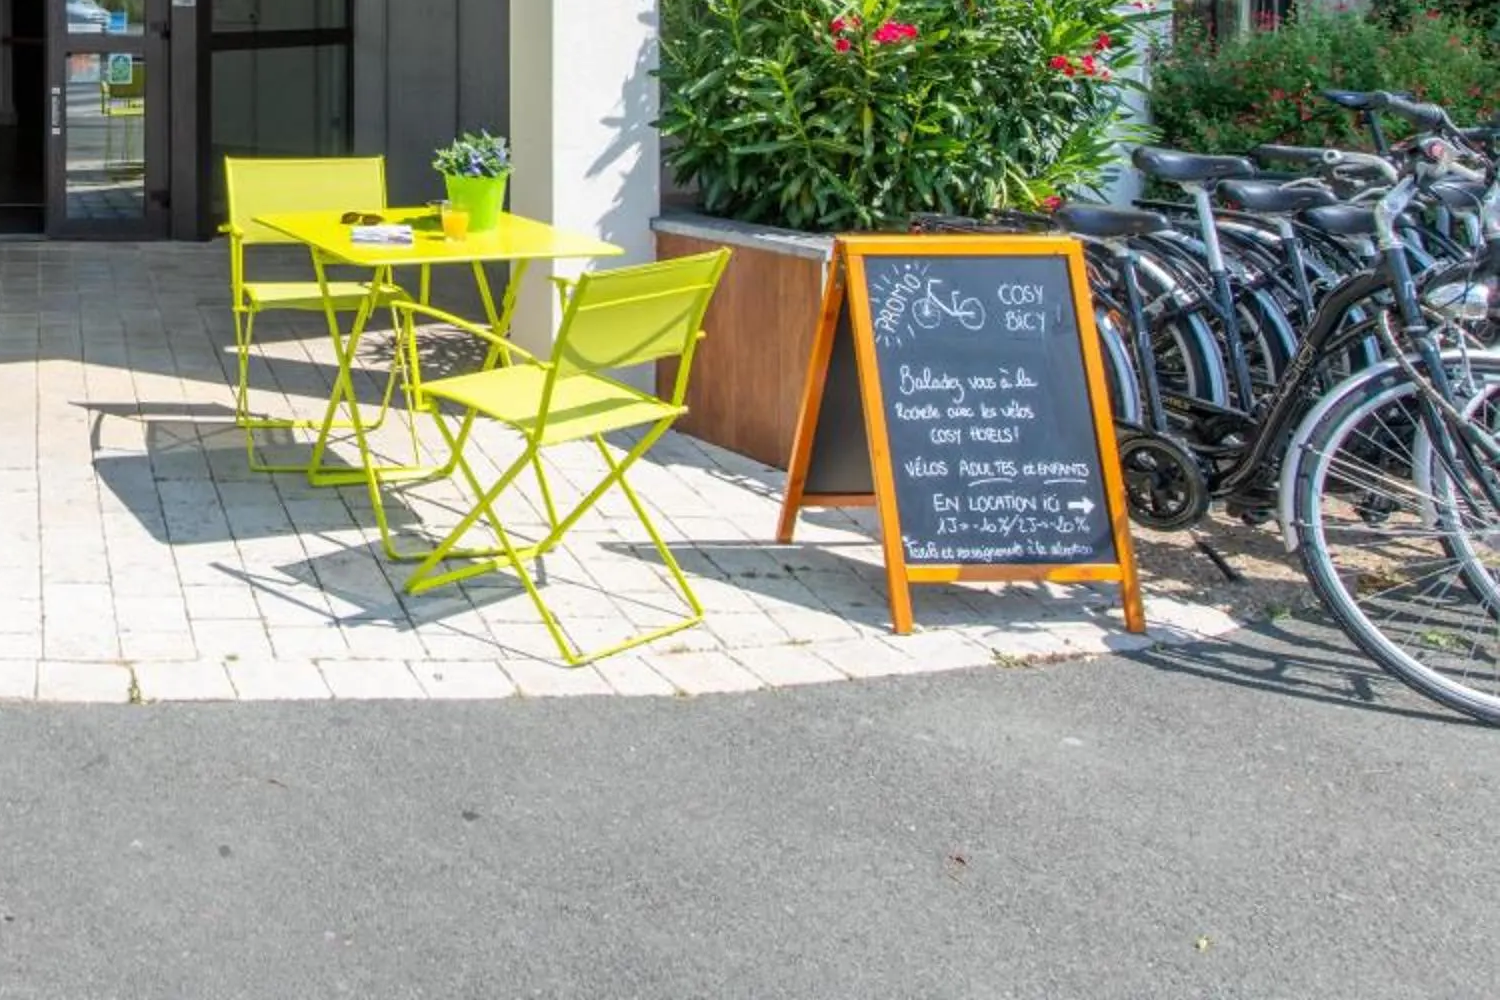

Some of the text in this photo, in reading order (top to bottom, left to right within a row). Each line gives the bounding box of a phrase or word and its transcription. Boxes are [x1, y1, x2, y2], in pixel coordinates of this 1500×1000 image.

[875, 273, 921, 334] PROMO
[997, 283, 1044, 305] COSY
[1015, 366, 1038, 387] la
[930, 427, 961, 445] COSY
[933, 493, 960, 512] EN
